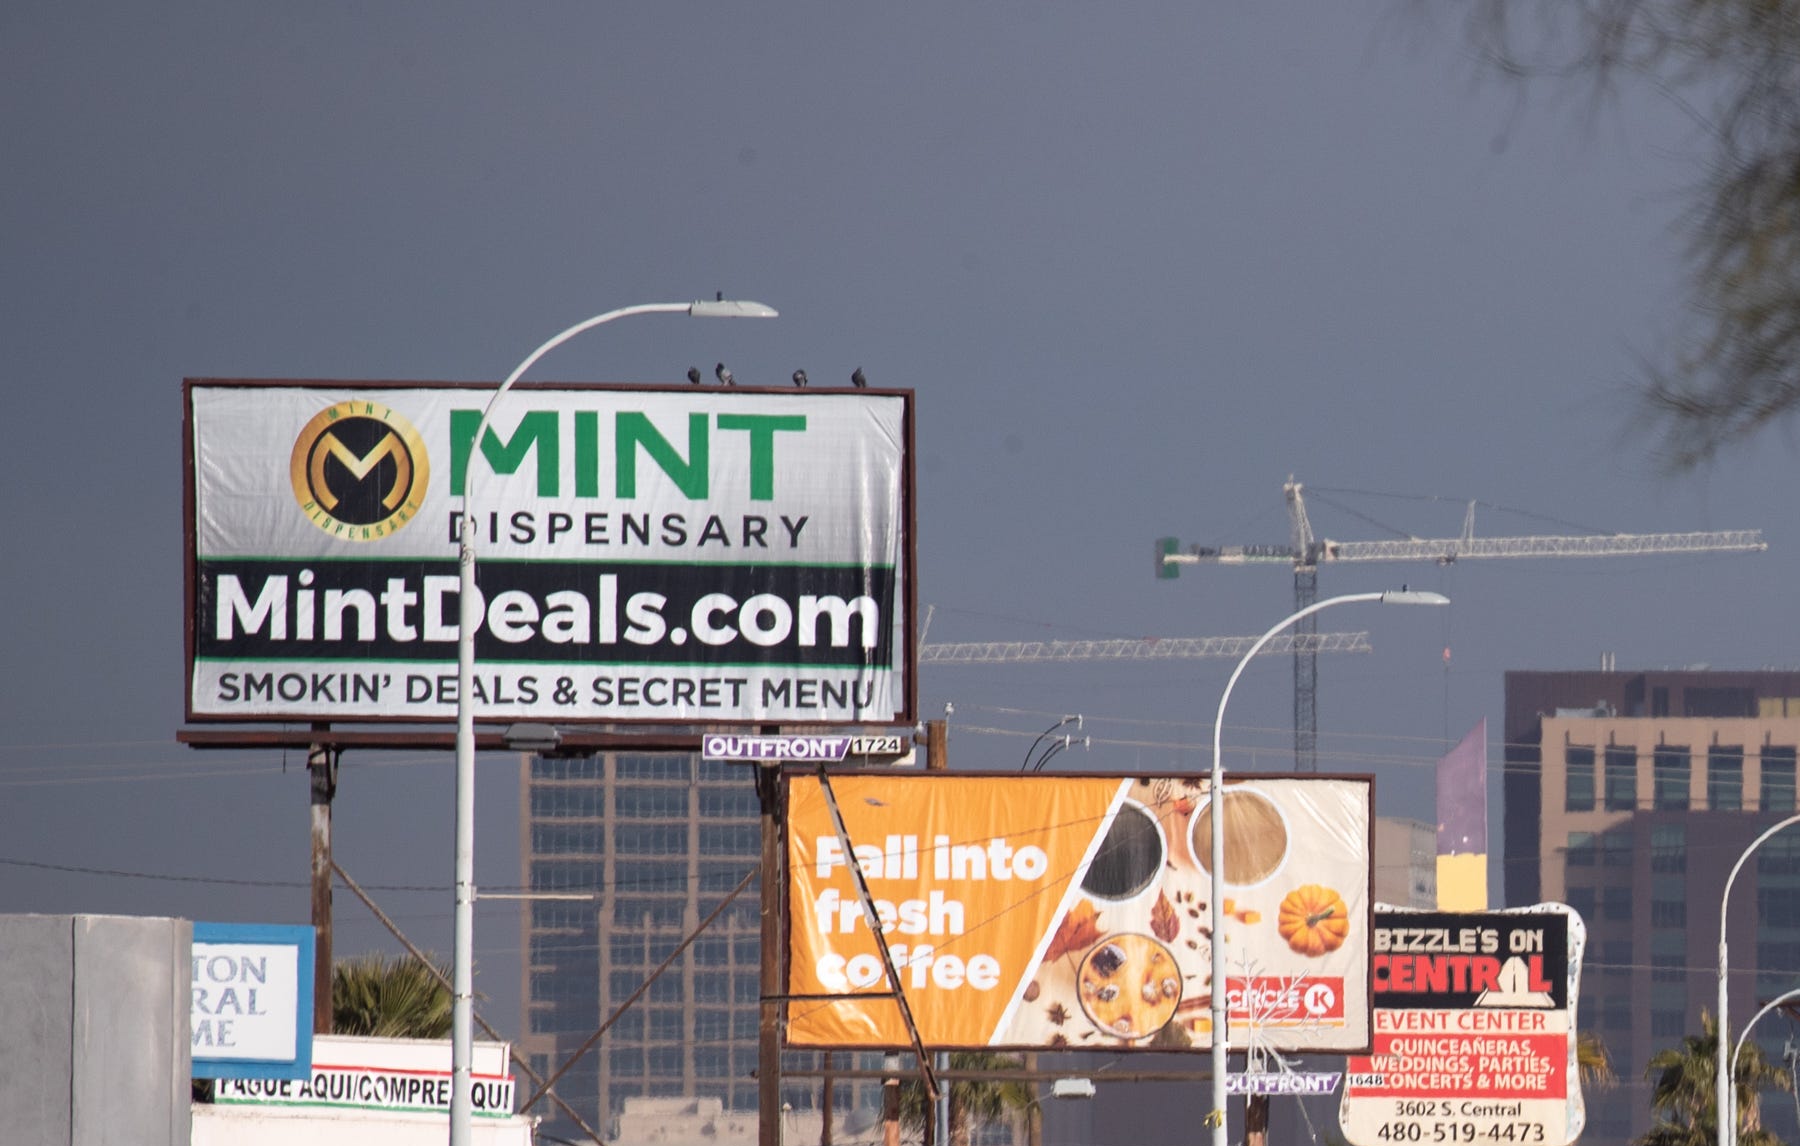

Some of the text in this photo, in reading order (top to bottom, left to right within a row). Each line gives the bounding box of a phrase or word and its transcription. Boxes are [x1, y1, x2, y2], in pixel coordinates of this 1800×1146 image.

[450, 409, 806, 501] MINT
[450, 511, 808, 548] DISPENSARY
[216, 569, 879, 647] MintDeals.com
[406, 674, 538, 705] DEALS
[552, 676, 577, 705] &
[592, 677, 747, 707] SECRET
[761, 678, 873, 709] MENU
[708, 737, 846, 758] OUTFRONT
[853, 737, 898, 752] 1724
[816, 834, 1048, 881] Fall into
[814, 888, 964, 936] fresh
[1374, 926, 1544, 953] BIZZLE'S ON
[815, 943, 1000, 991] coffee
[1374, 954, 1553, 996] CENTRAL
[1226, 988, 1300, 1013] CIRCLE
[1376, 1012, 1546, 1031] EVENT CENTER
[1389, 1037, 1537, 1057] QUINCEAÑERAS,
[1370, 1055, 1555, 1076] WEDDINGS, PARTIES,
[1226, 1075, 1333, 1093] OUTFRONT
[1349, 1073, 1384, 1087] 1648
[1382, 1073, 1548, 1091] CONCERTS & MORE
[1395, 1101, 1522, 1117] 3602 S. Central
[1377, 1121, 1545, 1144] 480-519-4473
